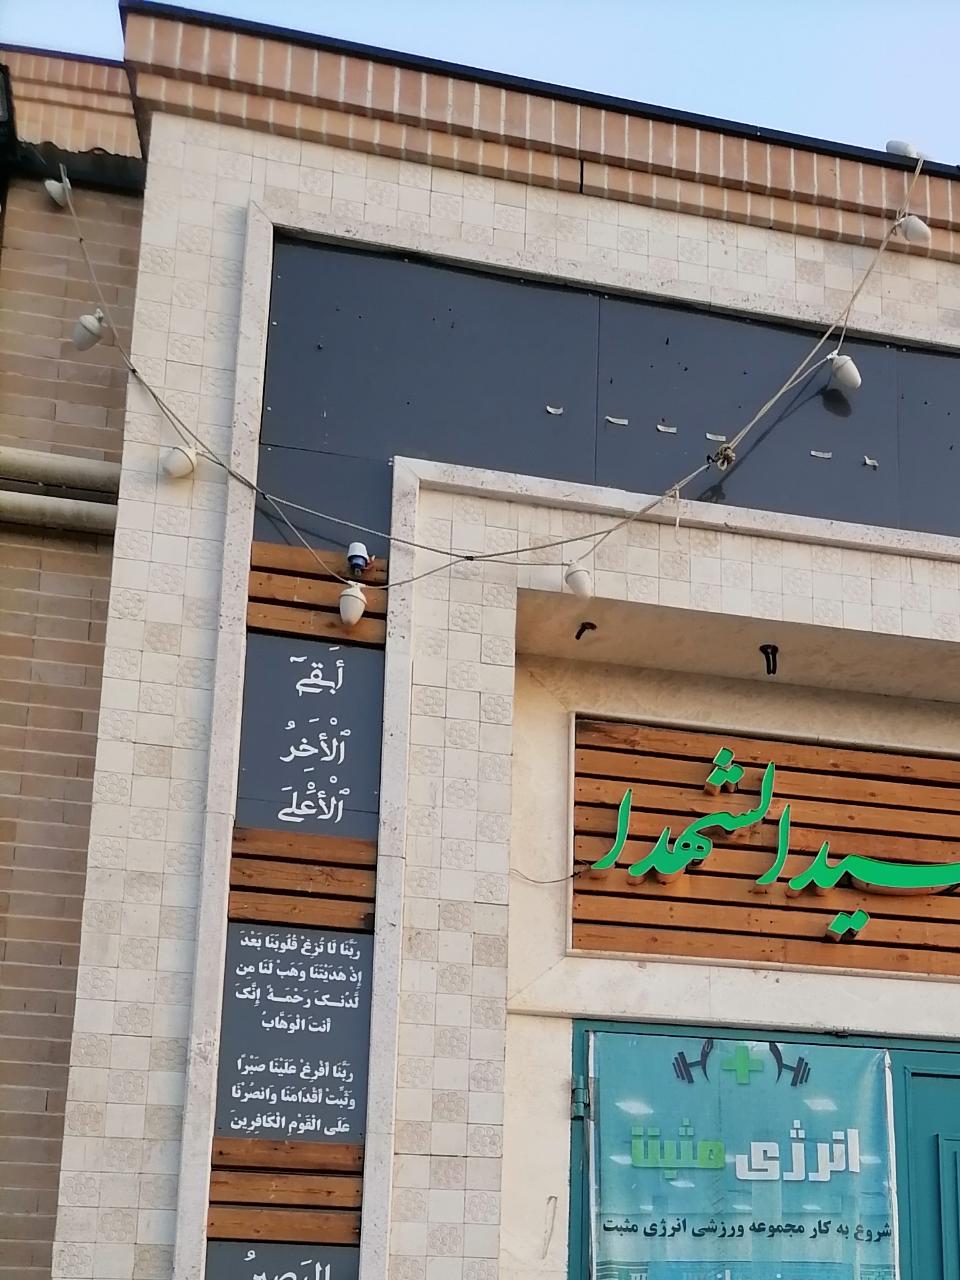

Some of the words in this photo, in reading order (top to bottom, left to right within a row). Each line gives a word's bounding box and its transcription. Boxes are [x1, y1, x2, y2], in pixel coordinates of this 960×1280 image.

[631, 1117, 726, 1180] مثبت
[735, 1119, 860, 1182] انرژی
[602, 1217, 638, 1237] مثبت
[643, 1218, 687, 1238] انرژی
[692, 1219, 745, 1238] ورزشی
[750, 1221, 805, 1238] مجموعه
[809, 1220, 831, 1239] کار
[836, 1224, 849, 1240] به
[854, 1220, 892, 1243] شروع
